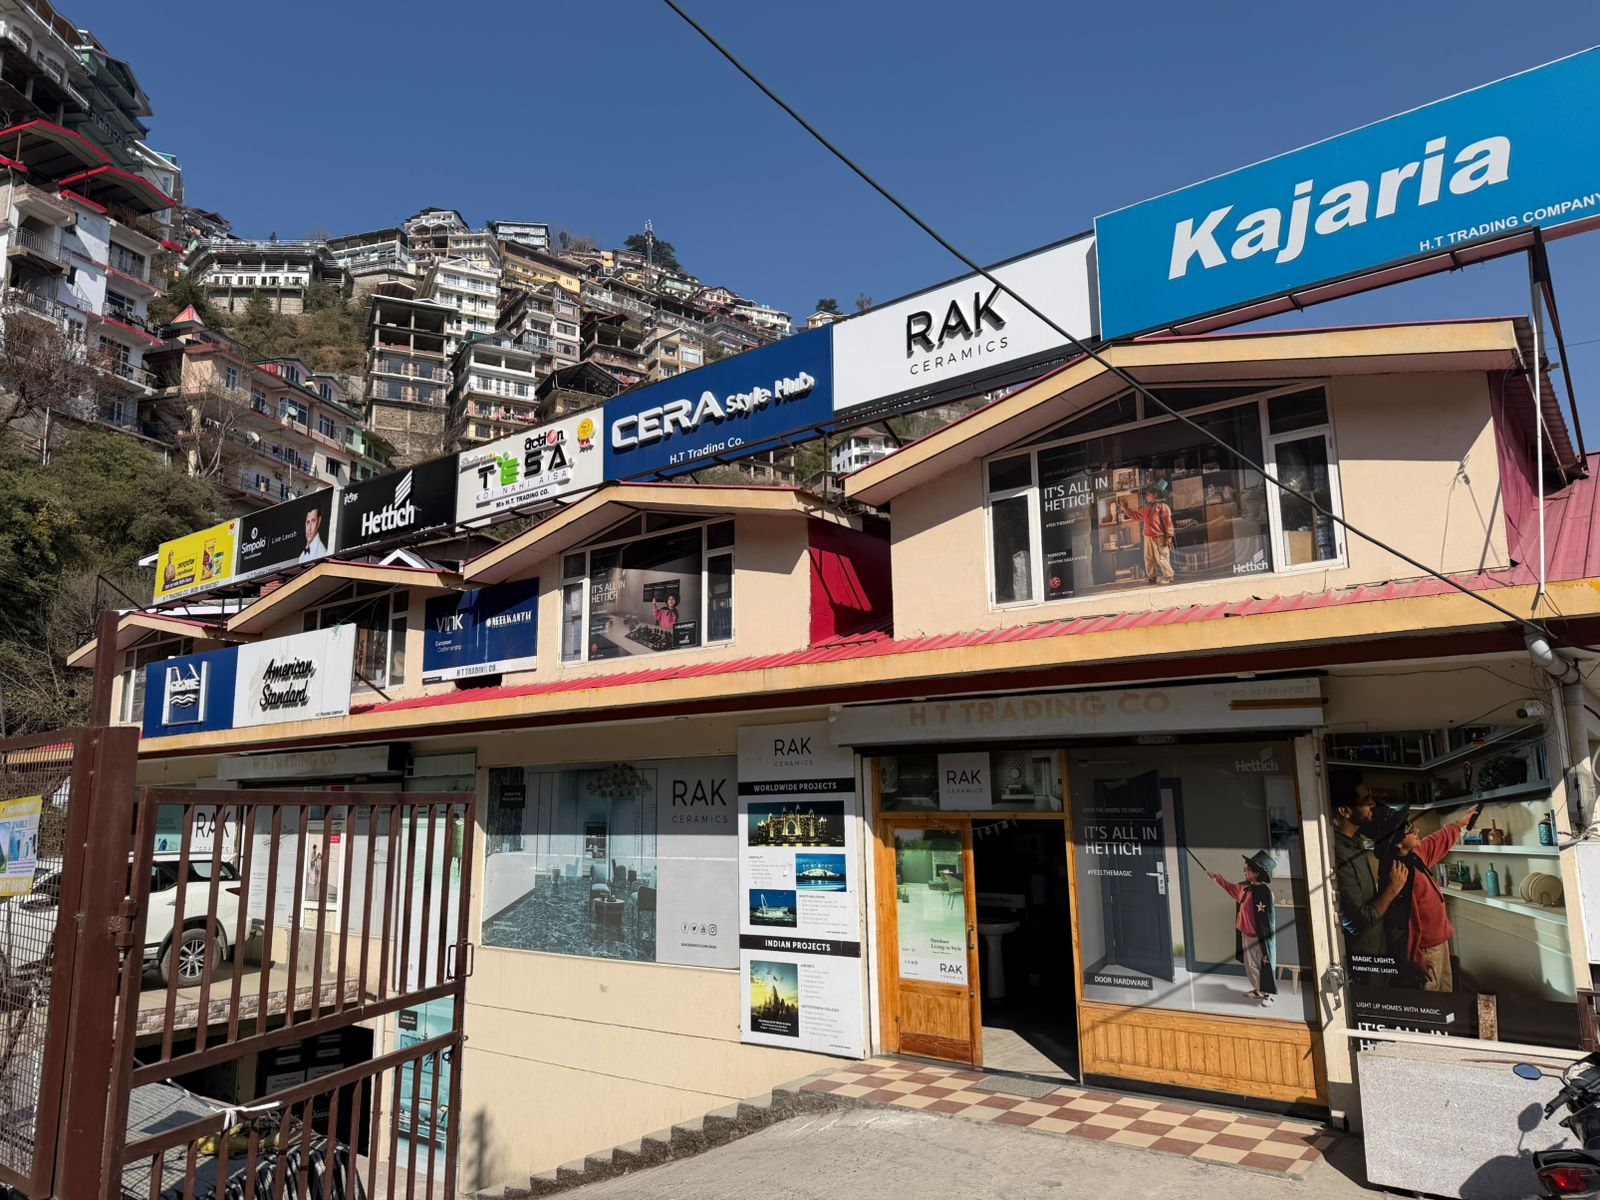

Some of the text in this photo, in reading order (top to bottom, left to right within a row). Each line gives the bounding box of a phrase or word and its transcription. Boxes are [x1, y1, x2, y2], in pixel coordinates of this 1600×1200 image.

[1168, 136, 1511, 280] Kajaria
[1420, 193, 1600, 251] H.T TRADING COMPANY
[905, 285, 1005, 354] RAK
[910, 337, 1008, 375] CERAMICS
[611, 391, 726, 448] CERA
[774, 371, 815, 399] Hub
[670, 437, 744, 464] H.T Trading Co.
[478, 444, 567, 489] TESA
[476, 470, 567, 501] KOI NAHI AISA
[1044, 476, 1109, 499] IT'S ALL IN
[516, 493, 539, 503] TRADING
[1044, 492, 1095, 512] HETTICH
[361, 499, 415, 537] Hettich
[241, 538, 266, 553] Simpolo
[1233, 559, 1269, 574] Hettich
[592, 580, 626, 593] IT'S ALL IN
[263, 656, 313, 680] American
[259, 680, 308, 706] Standard
[960, 695, 1106, 723] TRADING
[774, 737, 812, 757] RAK
[271, 753, 317, 769] TRADING
[774, 759, 813, 767] CERAMICS
[1236, 758, 1279, 772] Hettich
[946, 770, 982, 785] RAK
[672, 778, 727, 806] RAK
[754, 782, 837, 792] WORLDWIDE PROJECTS
[196, 811, 231, 838] RAK
[671, 814, 728, 824] CERAMICS
[1084, 826, 1157, 840] IT'S ALL IN
[1085, 842, 1142, 856] HETTICH
[1088, 869, 1133, 877] #FEELTHEMAGIC
[765, 939, 831, 951] INDIAN PROJECTS
[1352, 955, 1396, 965] MAGIC LIGHTS
[940, 963, 963, 975] RAK
[1352, 965, 1380, 974] FURNITURE
[1094, 975, 1150, 988] DOOR HARDWARE
[1382, 1004, 1402, 1012] HOMES
